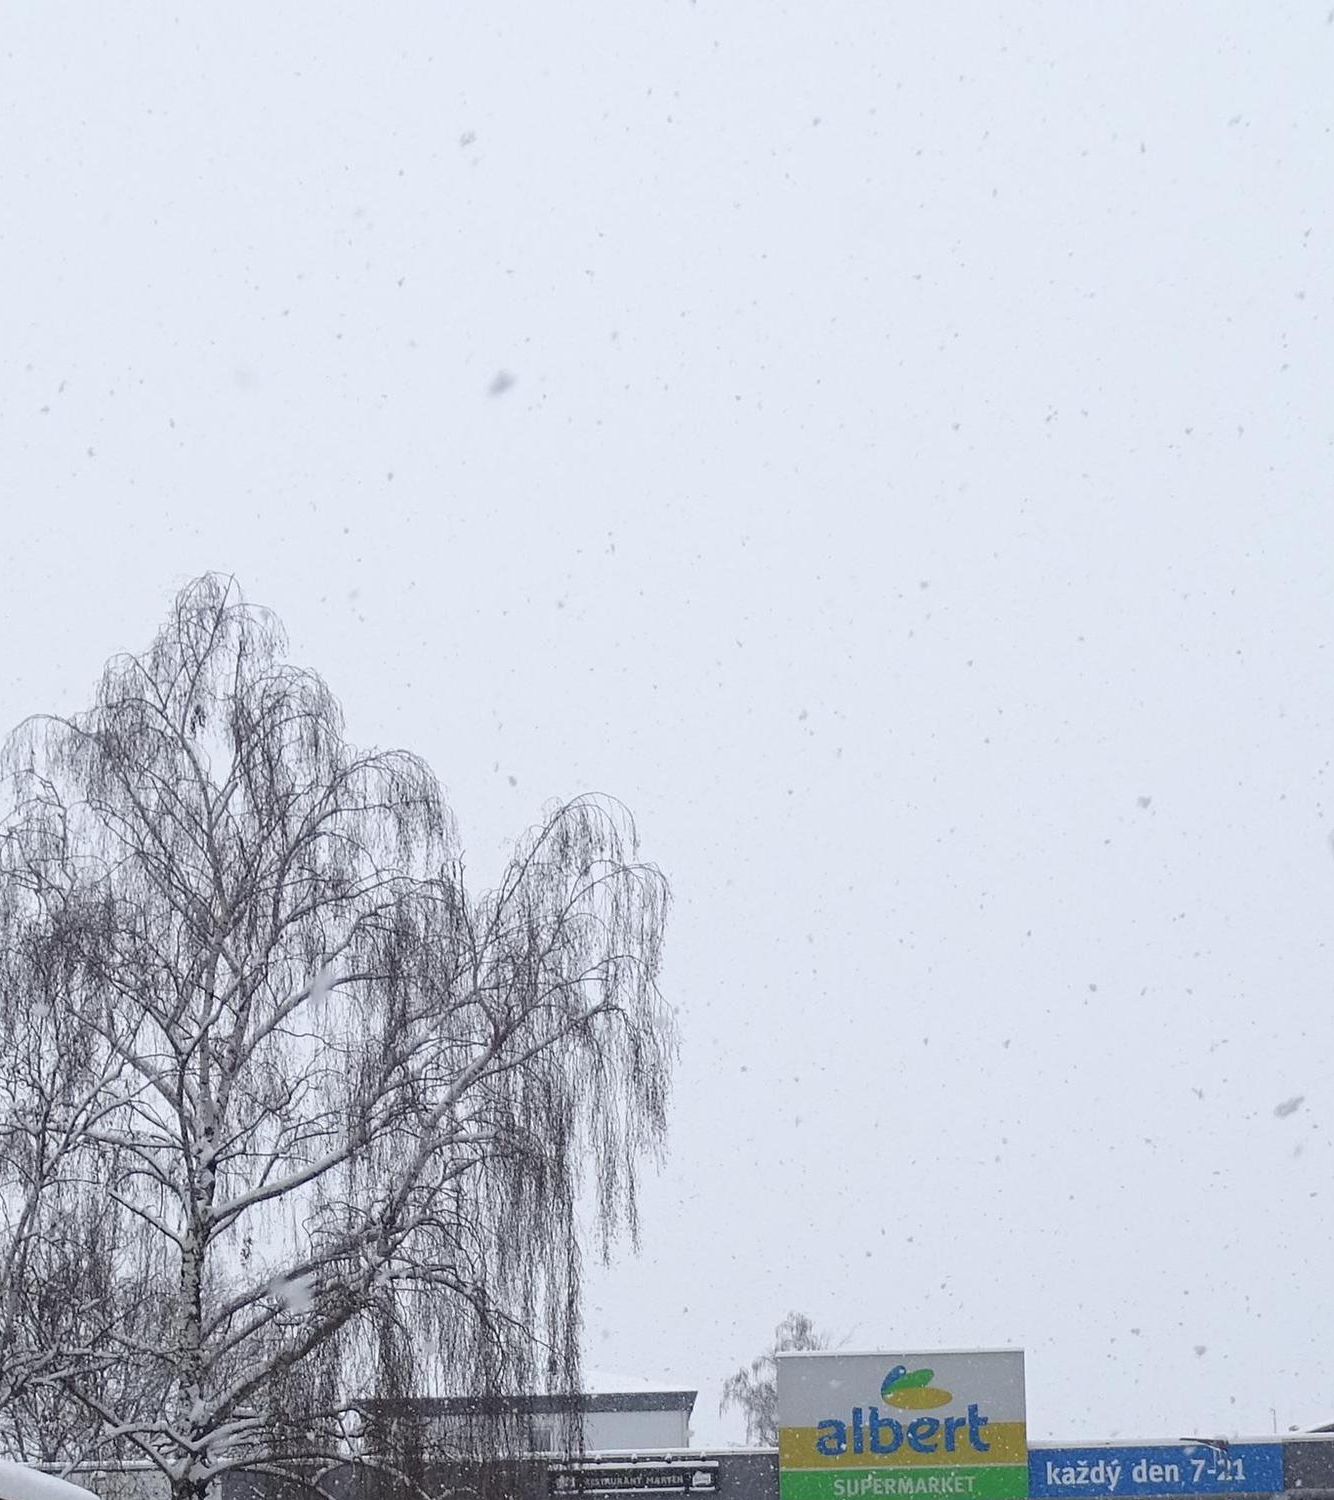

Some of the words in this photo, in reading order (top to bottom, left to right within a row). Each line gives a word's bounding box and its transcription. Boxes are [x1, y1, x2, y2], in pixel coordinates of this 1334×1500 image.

[816, 1403, 991, 1456] albert
[833, 1475, 976, 1497] SUPERMARKET
[1046, 1458, 1121, 1491] každý
[1132, 1458, 1180, 1483] den
